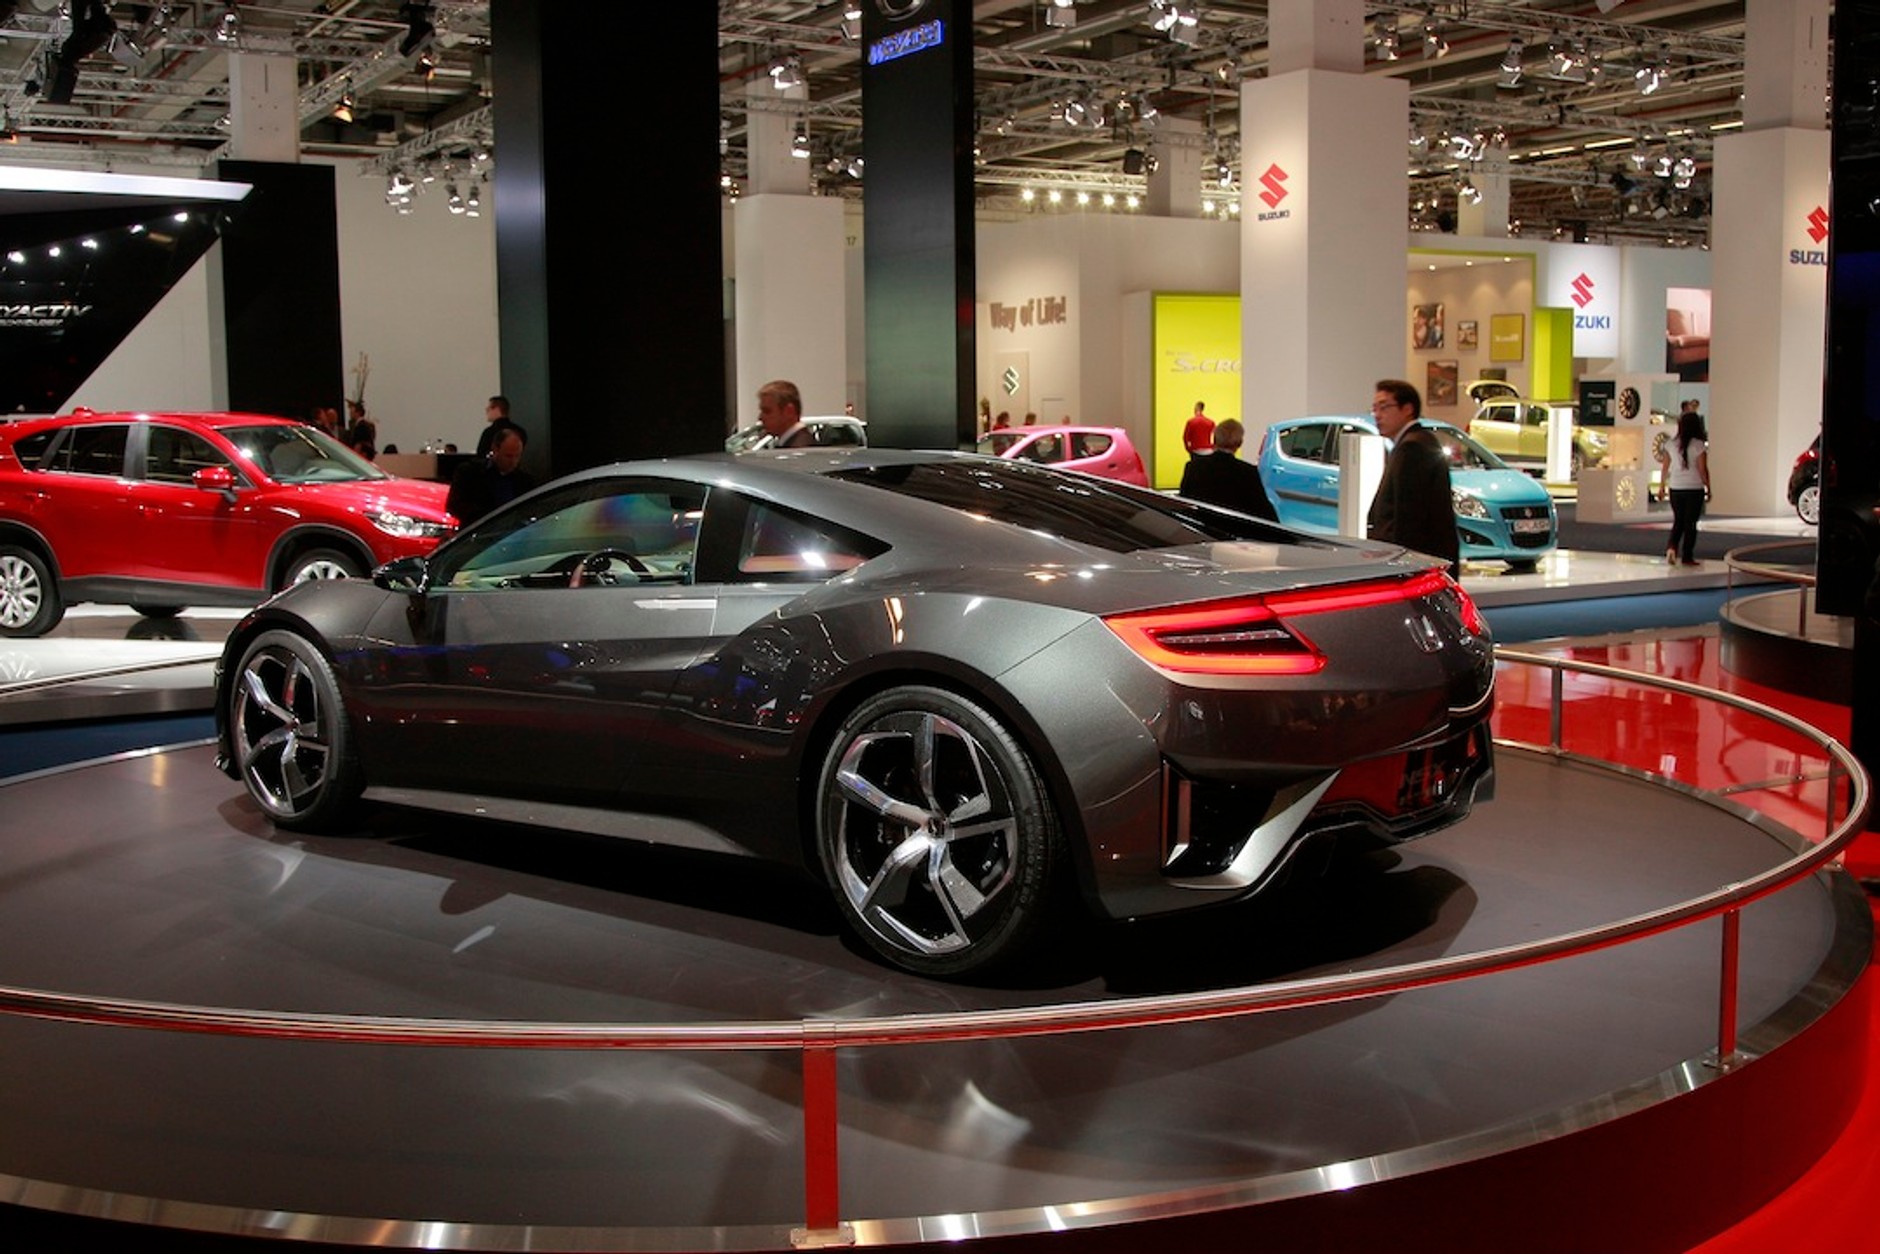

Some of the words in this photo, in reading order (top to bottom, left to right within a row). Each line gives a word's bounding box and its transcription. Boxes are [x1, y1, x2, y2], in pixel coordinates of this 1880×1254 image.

[1258, 210, 1290, 221] SUZUKI
[0, 304, 92, 317] YACTIV
[990, 302, 1017, 333] Way
[1020, 298, 1034, 327] of
